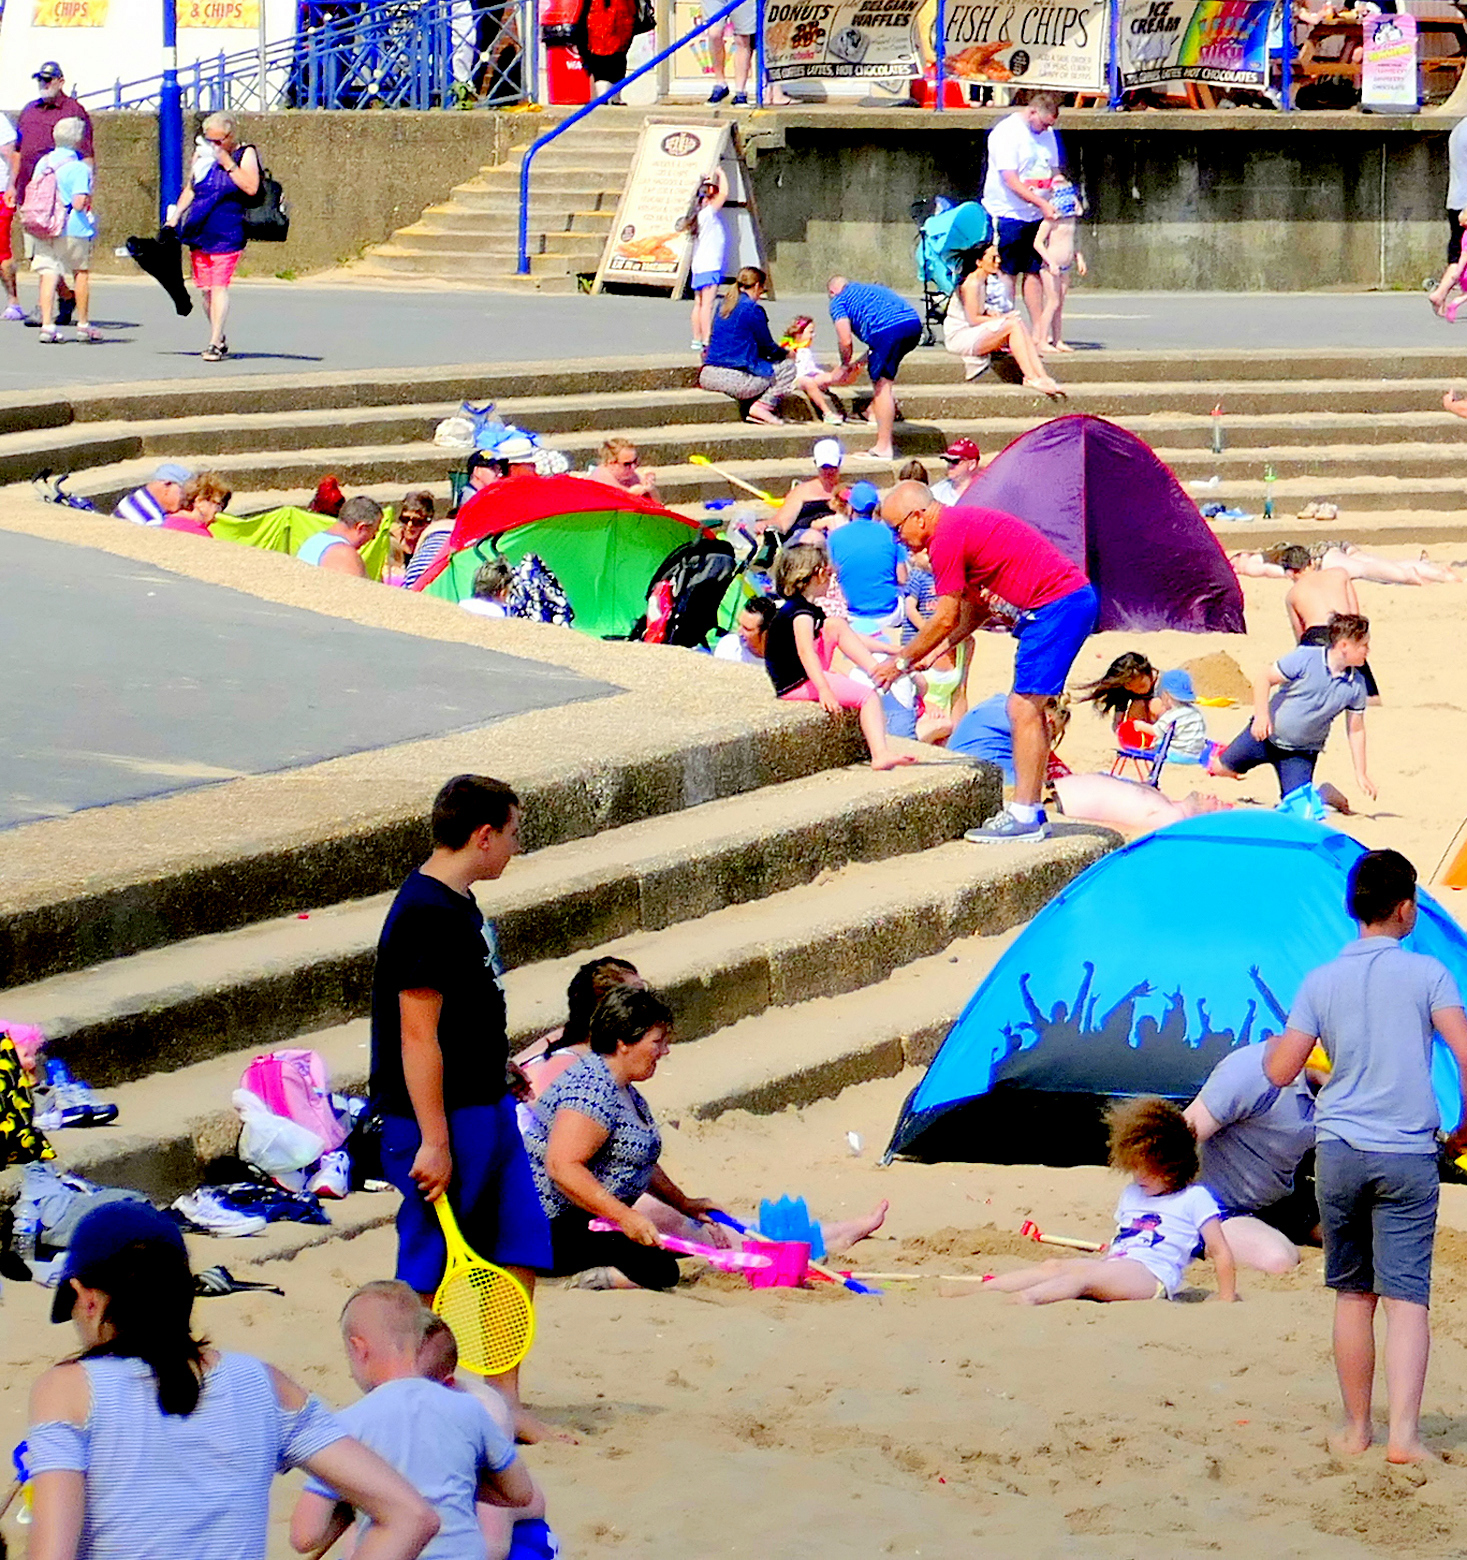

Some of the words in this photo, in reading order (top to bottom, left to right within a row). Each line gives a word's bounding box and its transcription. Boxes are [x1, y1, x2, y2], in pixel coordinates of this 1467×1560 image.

[54, 1, 88, 19] CHIPS
[191, 3, 199, 18] &
[204, 2, 243, 19] CHIPS
[768, 4, 833, 23] DONUTS
[859, 0, 918, 13] BELGIAN
[1149, 2, 1174, 17] ICE
[852, 13, 911, 27] WAFFLES
[944, 5, 998, 43] FISH
[999, 6, 1015, 42] &
[1020, 6, 1089, 48] CHIPS
[1131, 16, 1181, 34] CREAM
[1202, 69, 1258, 83] CHOCOLATES
